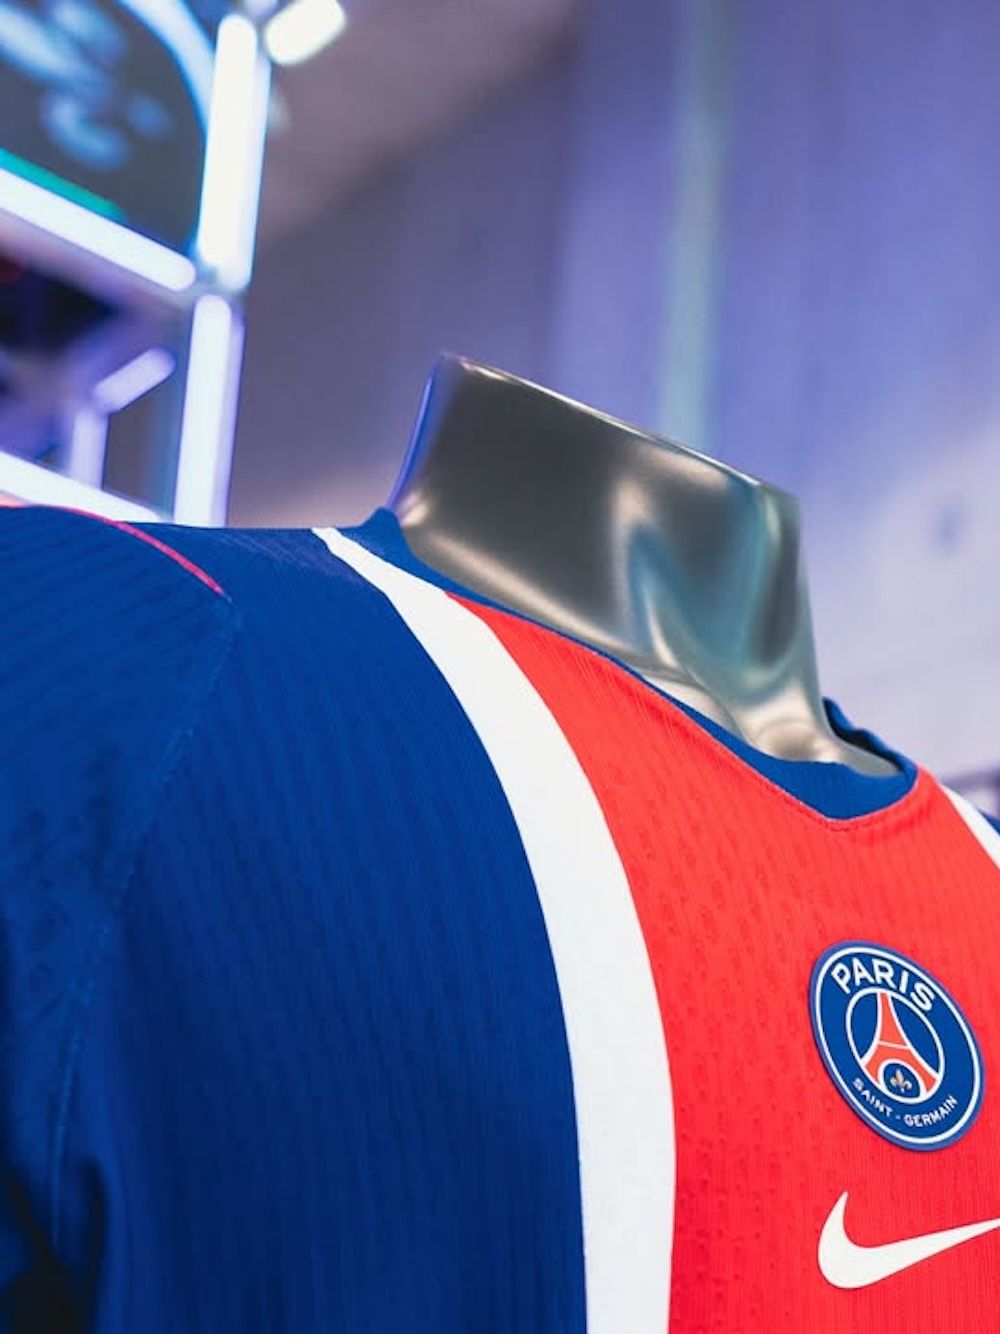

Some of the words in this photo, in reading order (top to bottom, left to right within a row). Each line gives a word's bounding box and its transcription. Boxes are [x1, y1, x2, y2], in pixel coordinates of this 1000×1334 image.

[831, 957, 935, 1012] PARIS
[852, 1077, 894, 1118] SAINT
[903, 1095, 959, 1128] GERMAIN
